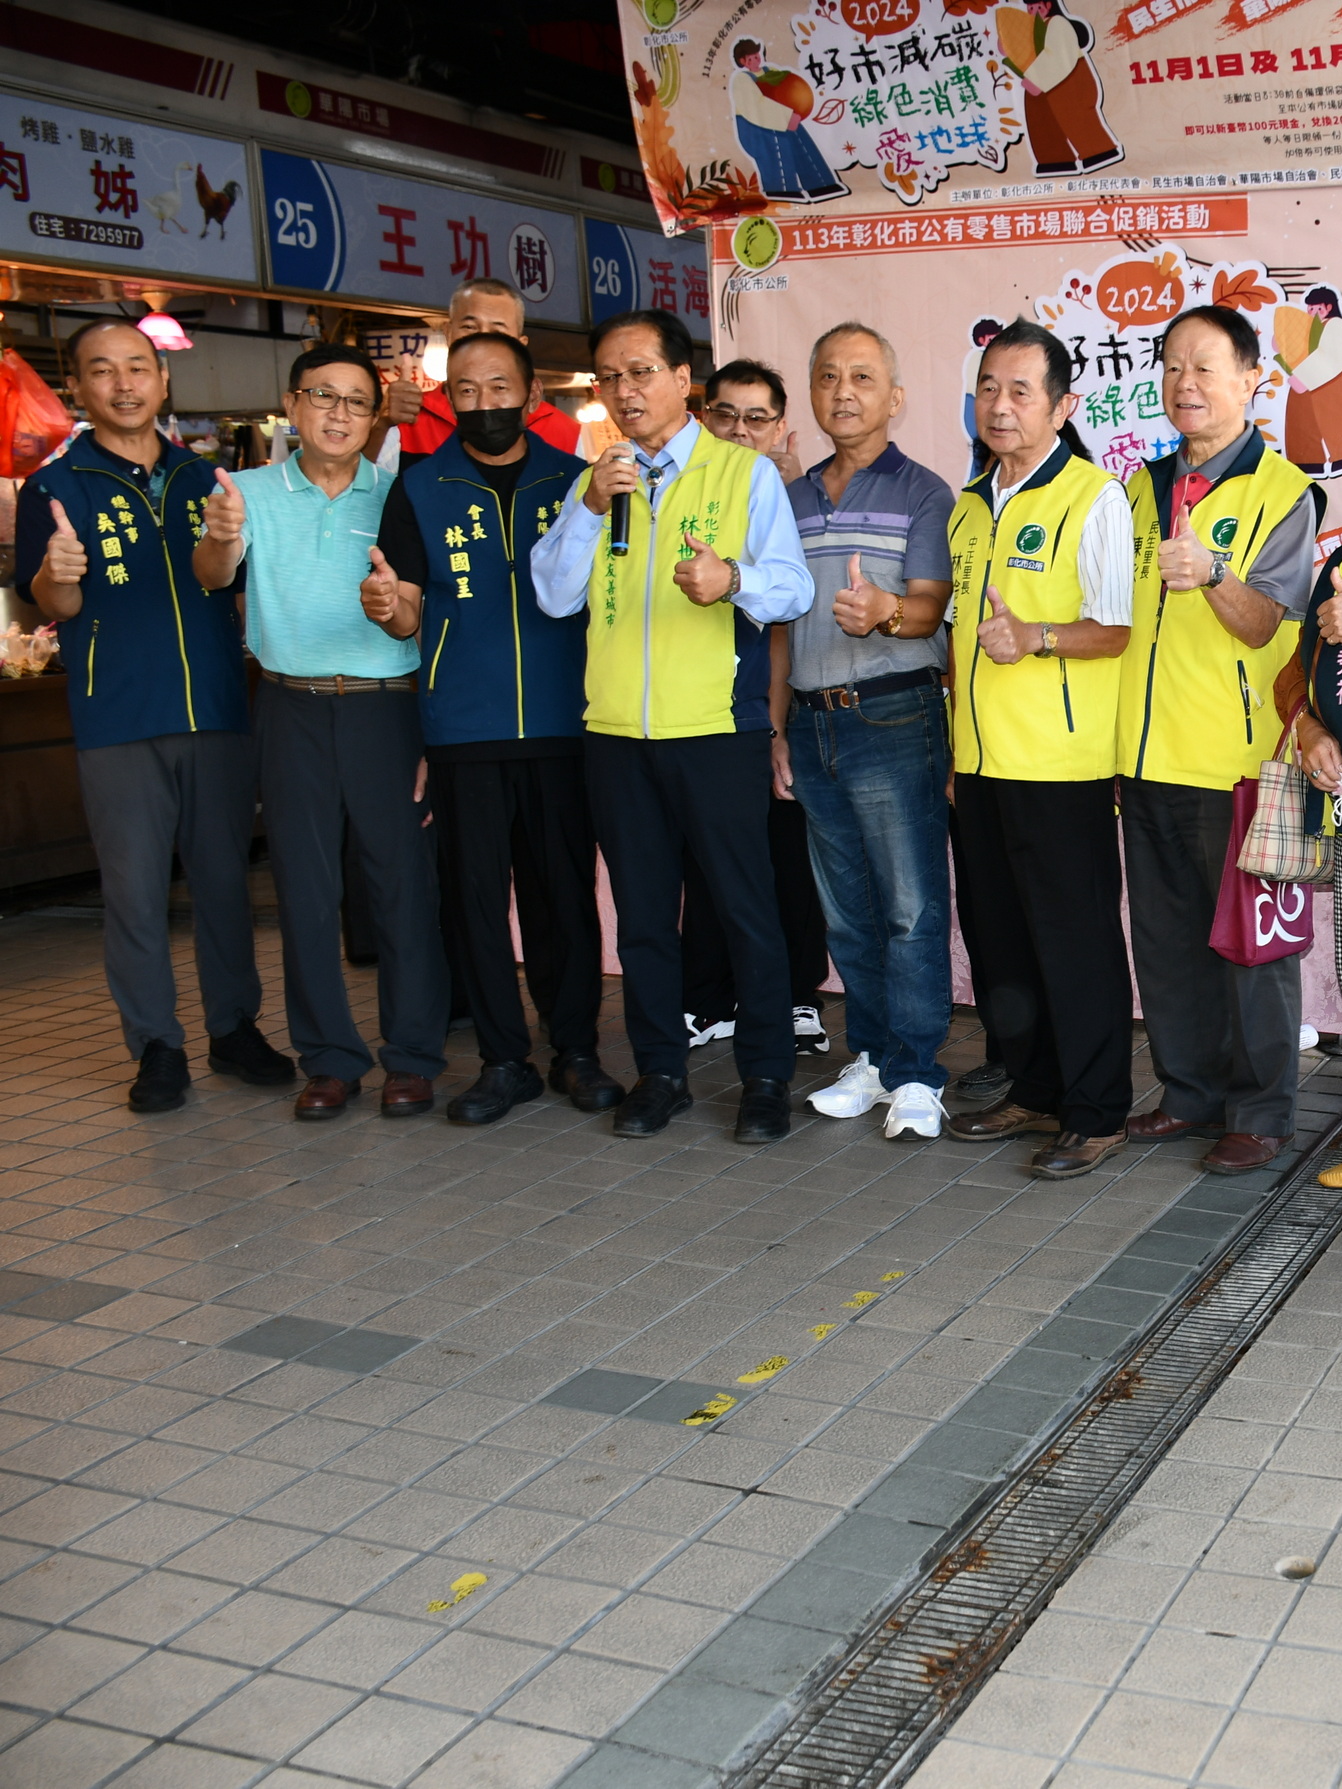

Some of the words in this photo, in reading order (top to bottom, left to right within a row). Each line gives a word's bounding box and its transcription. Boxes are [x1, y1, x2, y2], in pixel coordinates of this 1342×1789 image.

[643, 31, 689, 47] 彰化市公所
[849, 3, 914, 26] 2024
[804, 20, 984, 91] 好市減碳
[1250, 49, 1279, 74] 及
[849, 65, 986, 129] 綠色消費
[875, 114, 992, 173] 愛地球
[89, 159, 139, 220] 姊
[274, 197, 317, 249] 25
[792, 203, 1210, 251] 113年彰化市公有零售市場聯合促銷活動
[514, 233, 549, 294] 樹
[592, 256, 622, 297] 26
[729, 276, 788, 292] 彰化市公所
[1105, 282, 1176, 317] 2024
[467, 503, 488, 541] 會長
[97, 512, 130, 585] 吳國傑
[960, 536, 978, 596] 中正里長
[1139, 520, 1160, 580] 民生里長
